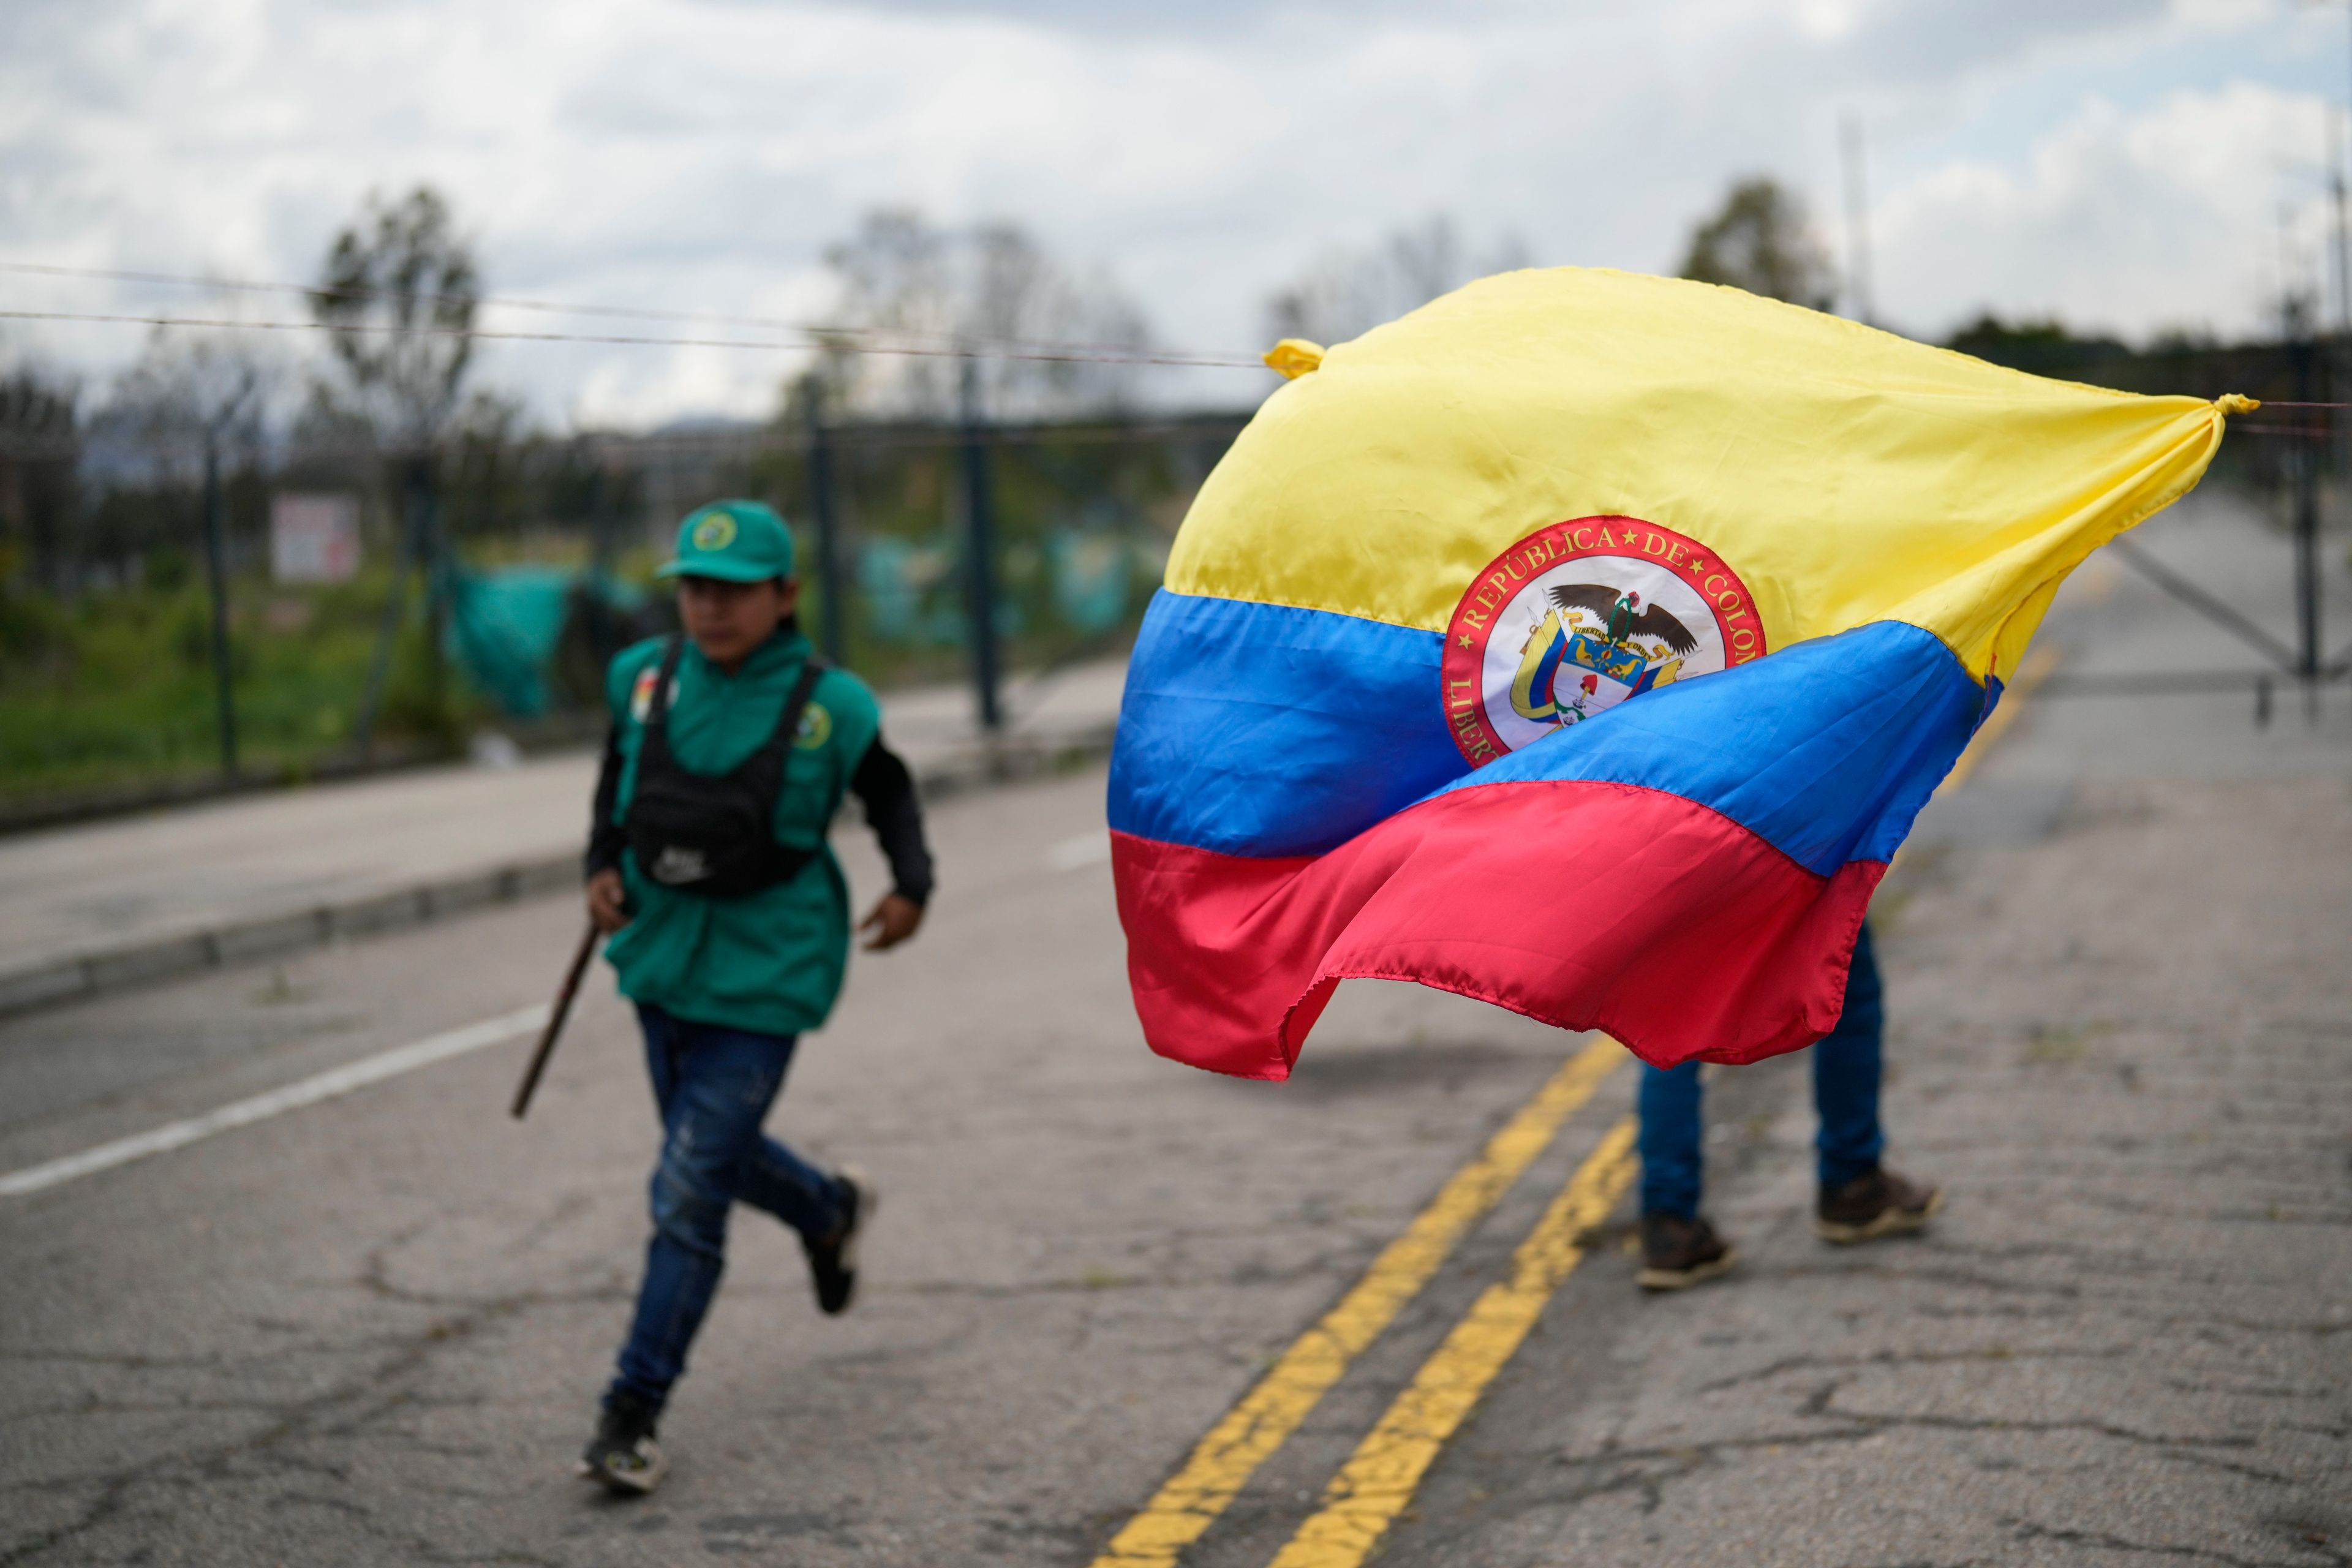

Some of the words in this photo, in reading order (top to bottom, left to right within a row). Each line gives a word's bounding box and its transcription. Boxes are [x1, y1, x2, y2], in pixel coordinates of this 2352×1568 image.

[1462, 527, 1618, 631] REPÚBLICA
[1641, 533, 1691, 567] DE
[1574, 627, 1605, 640] LIBERTAD
[1633, 644, 1653, 662] ORDEN
